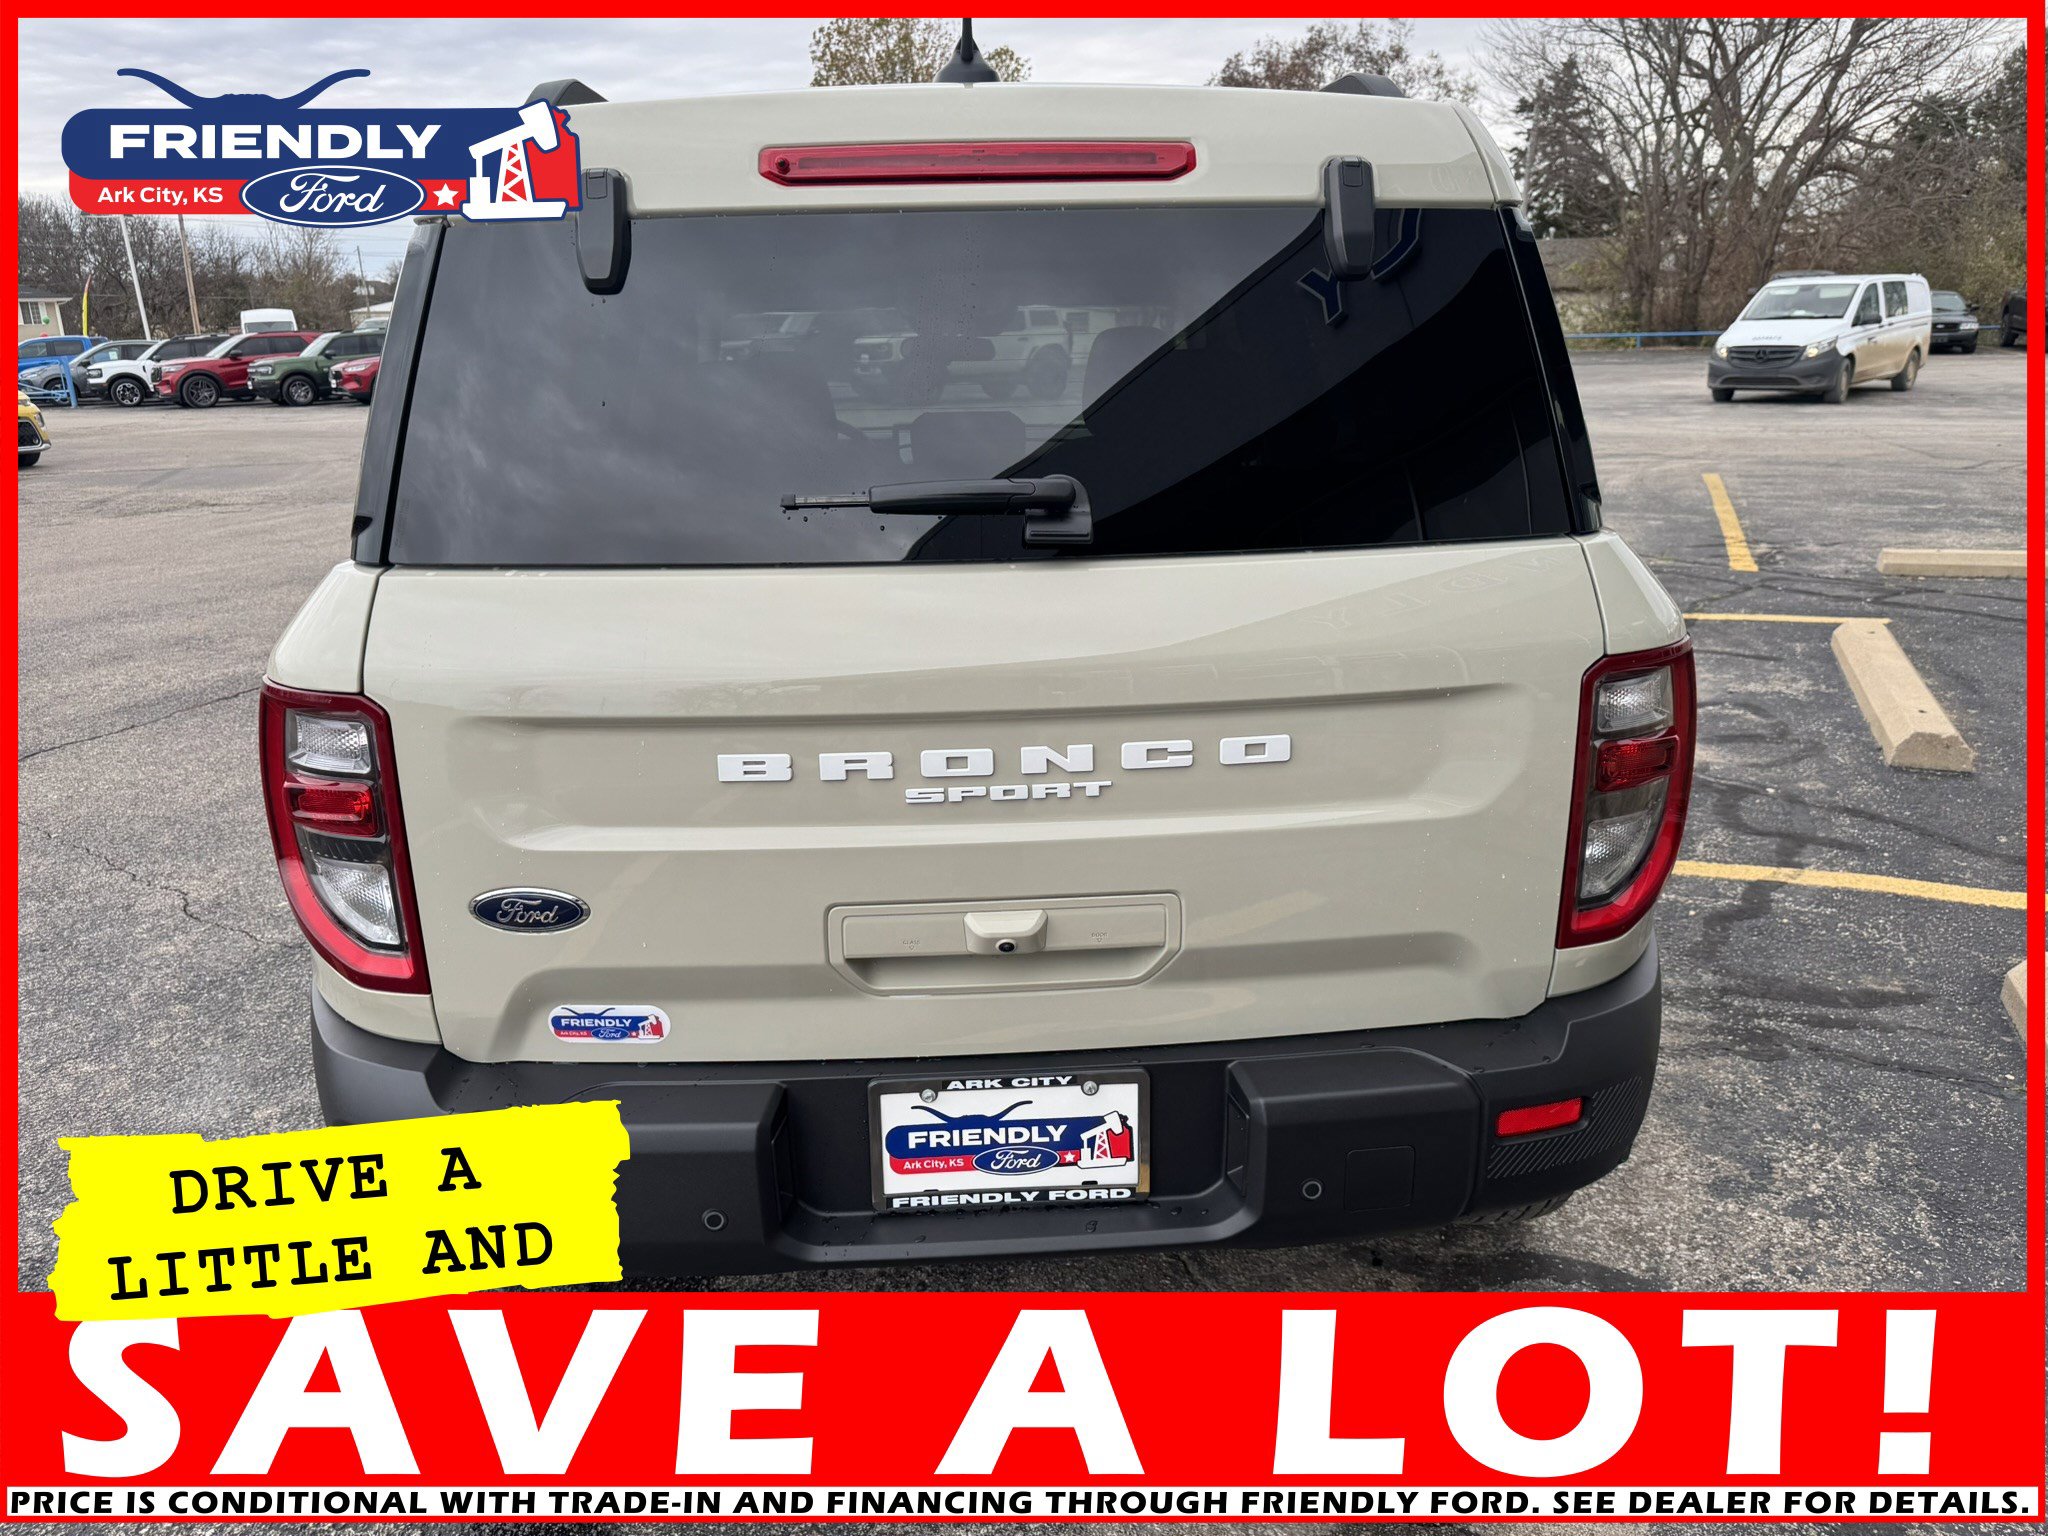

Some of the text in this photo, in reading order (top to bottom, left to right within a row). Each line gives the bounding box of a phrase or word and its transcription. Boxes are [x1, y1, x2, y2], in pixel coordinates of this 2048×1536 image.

[717, 734, 1291, 782] BRONCO
[905, 781, 1112, 804] SPORT
[496, 898, 559, 924] Ford
[561, 1018, 632, 1027] FRIENDLY
[598, 1028, 622, 1038] Ford
[947, 1076, 1073, 1090] ARK CITY
[908, 1124, 1069, 1149] FRIENDLY
[903, 1158, 965, 1170] Ark City, KS
[990, 1149, 1042, 1170] Ford
[892, 1189, 1132, 1209] FRIENDLY FORD
